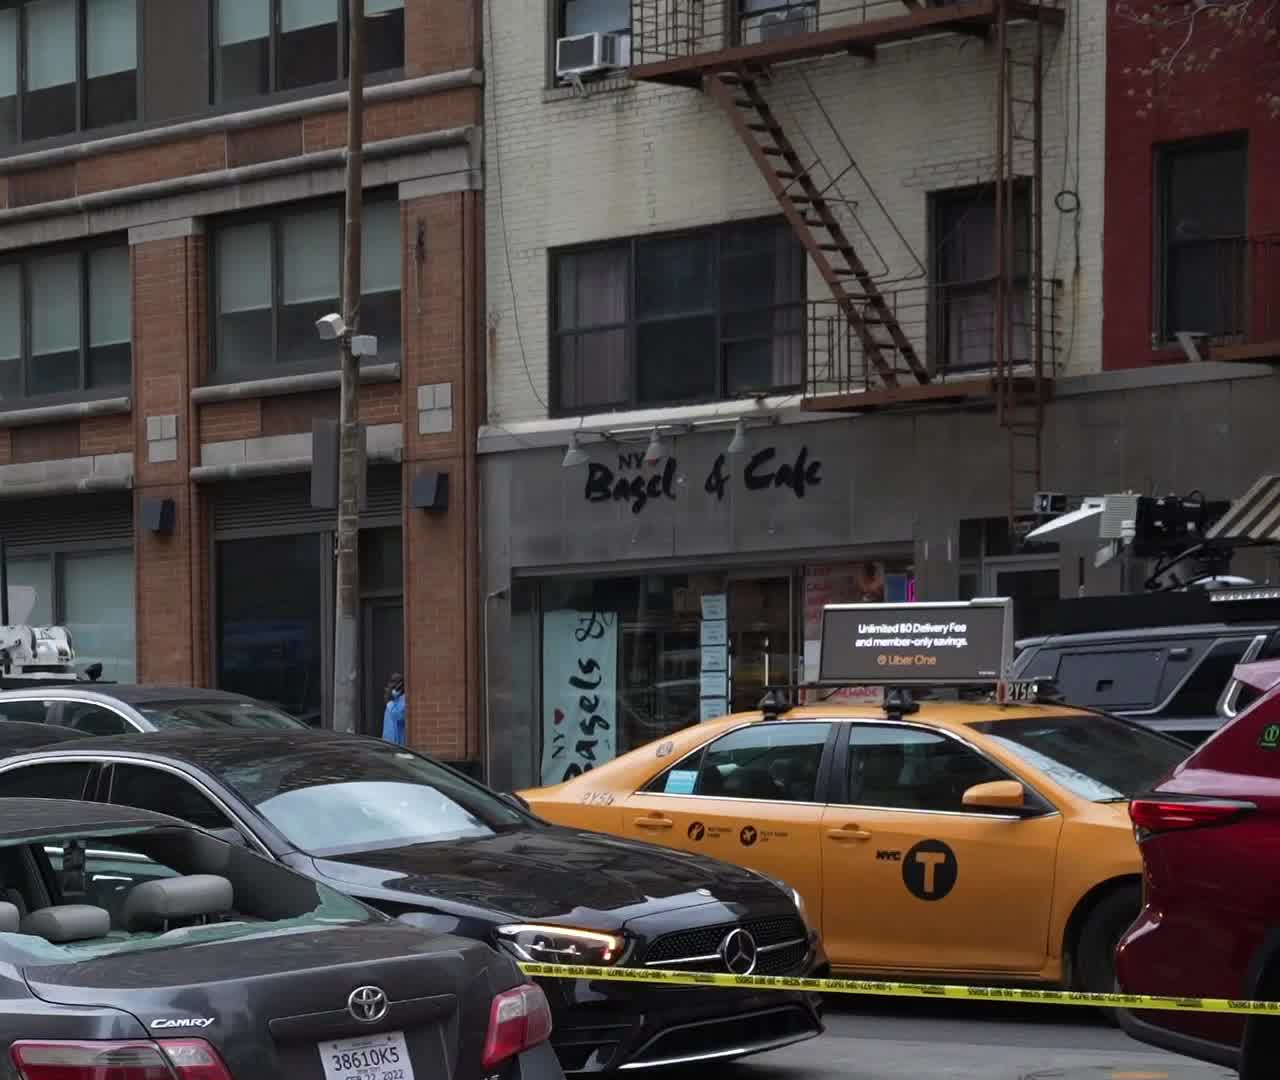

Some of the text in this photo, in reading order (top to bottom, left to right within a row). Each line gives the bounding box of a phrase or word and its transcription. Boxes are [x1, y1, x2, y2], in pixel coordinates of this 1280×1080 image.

[617, 452, 646, 470] NY
[584, 457, 678, 514] Bagel
[743, 445, 822, 499] Cafe
[858, 623, 899, 634] Unlimited
[913, 623, 949, 635] Delivery
[949, 622, 967, 633] Fee
[855, 638, 872, 648] and
[873, 637, 933, 649] member-only
[888, 655, 937, 666] Uber One
[875, 850, 902, 862] NYC
[150, 1017, 215, 1029] CAMRY
[331, 1046, 400, 1072] 38610K5
